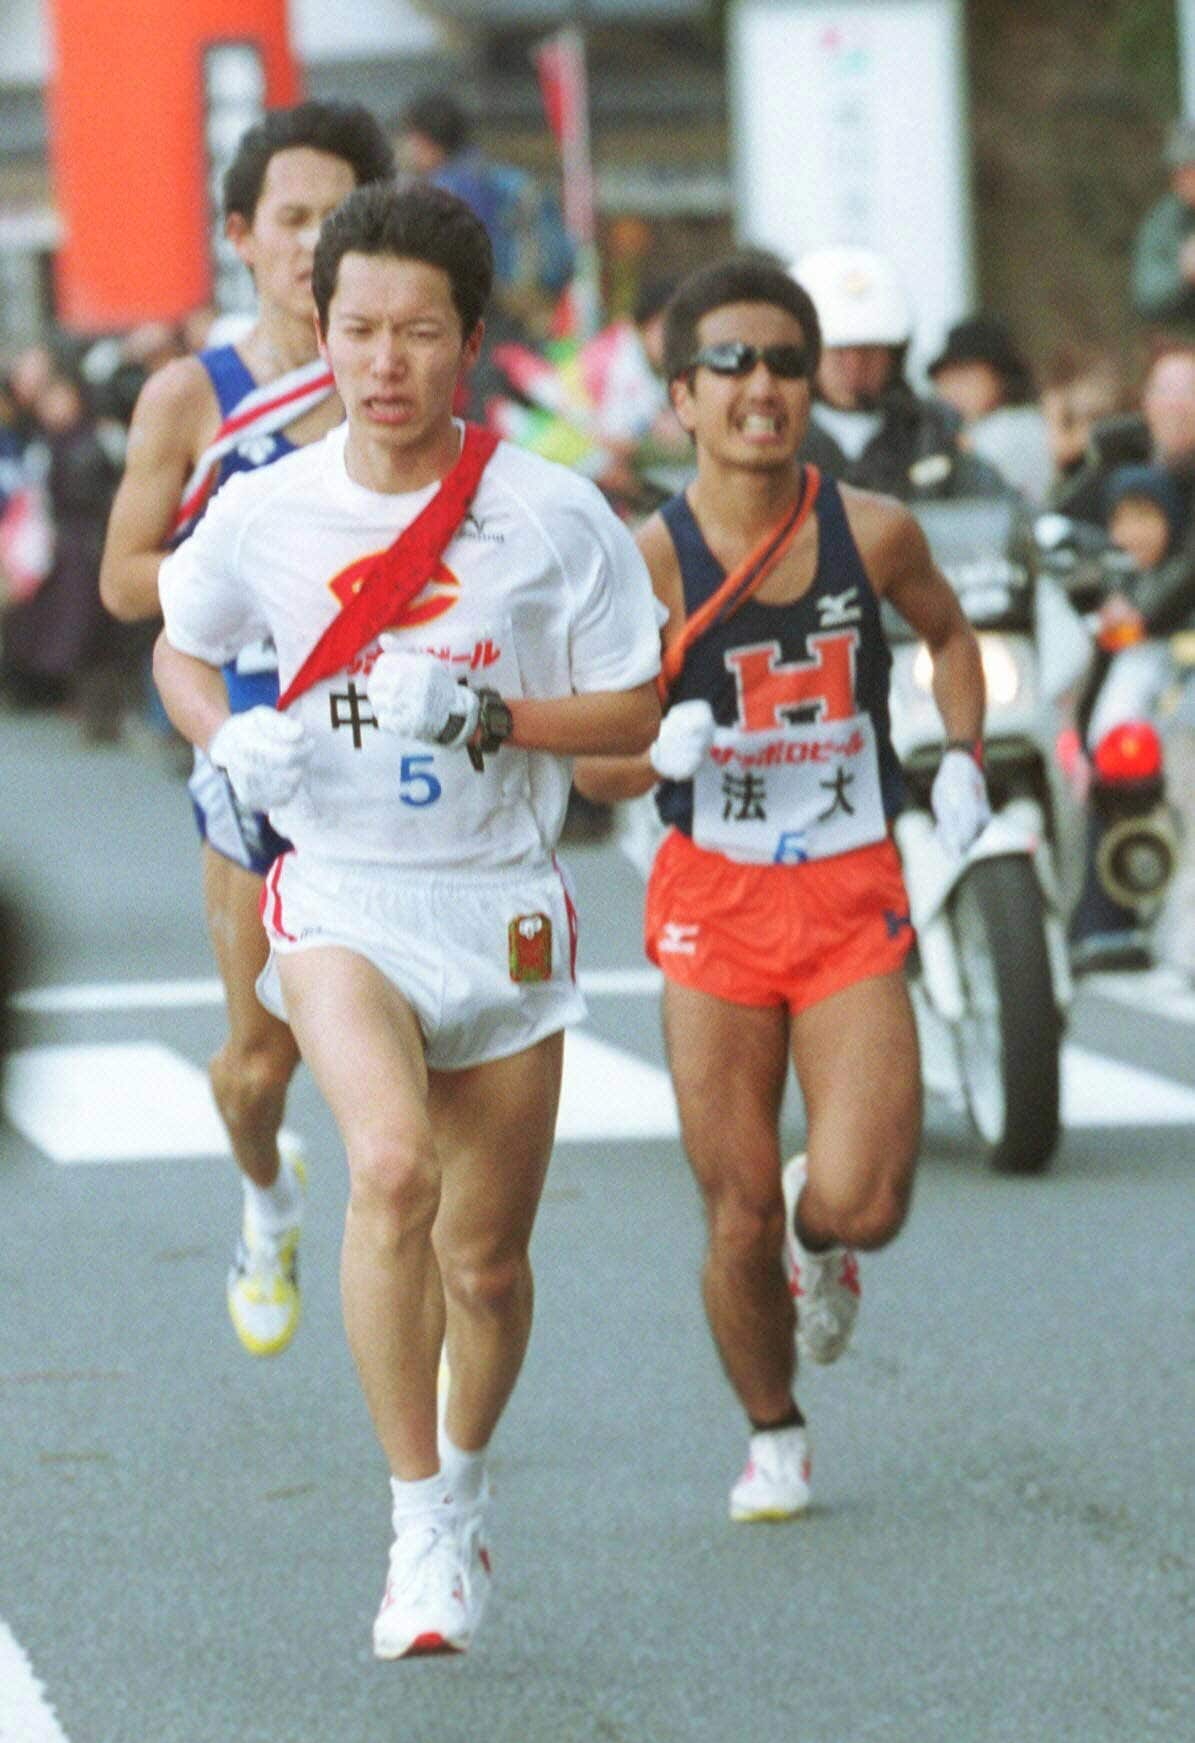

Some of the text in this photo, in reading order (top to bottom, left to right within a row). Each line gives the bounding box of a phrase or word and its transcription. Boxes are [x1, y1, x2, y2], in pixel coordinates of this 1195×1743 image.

[725, 628, 860, 732] H
[399, 754, 442, 807] 5
[774, 831, 808, 864] 5
